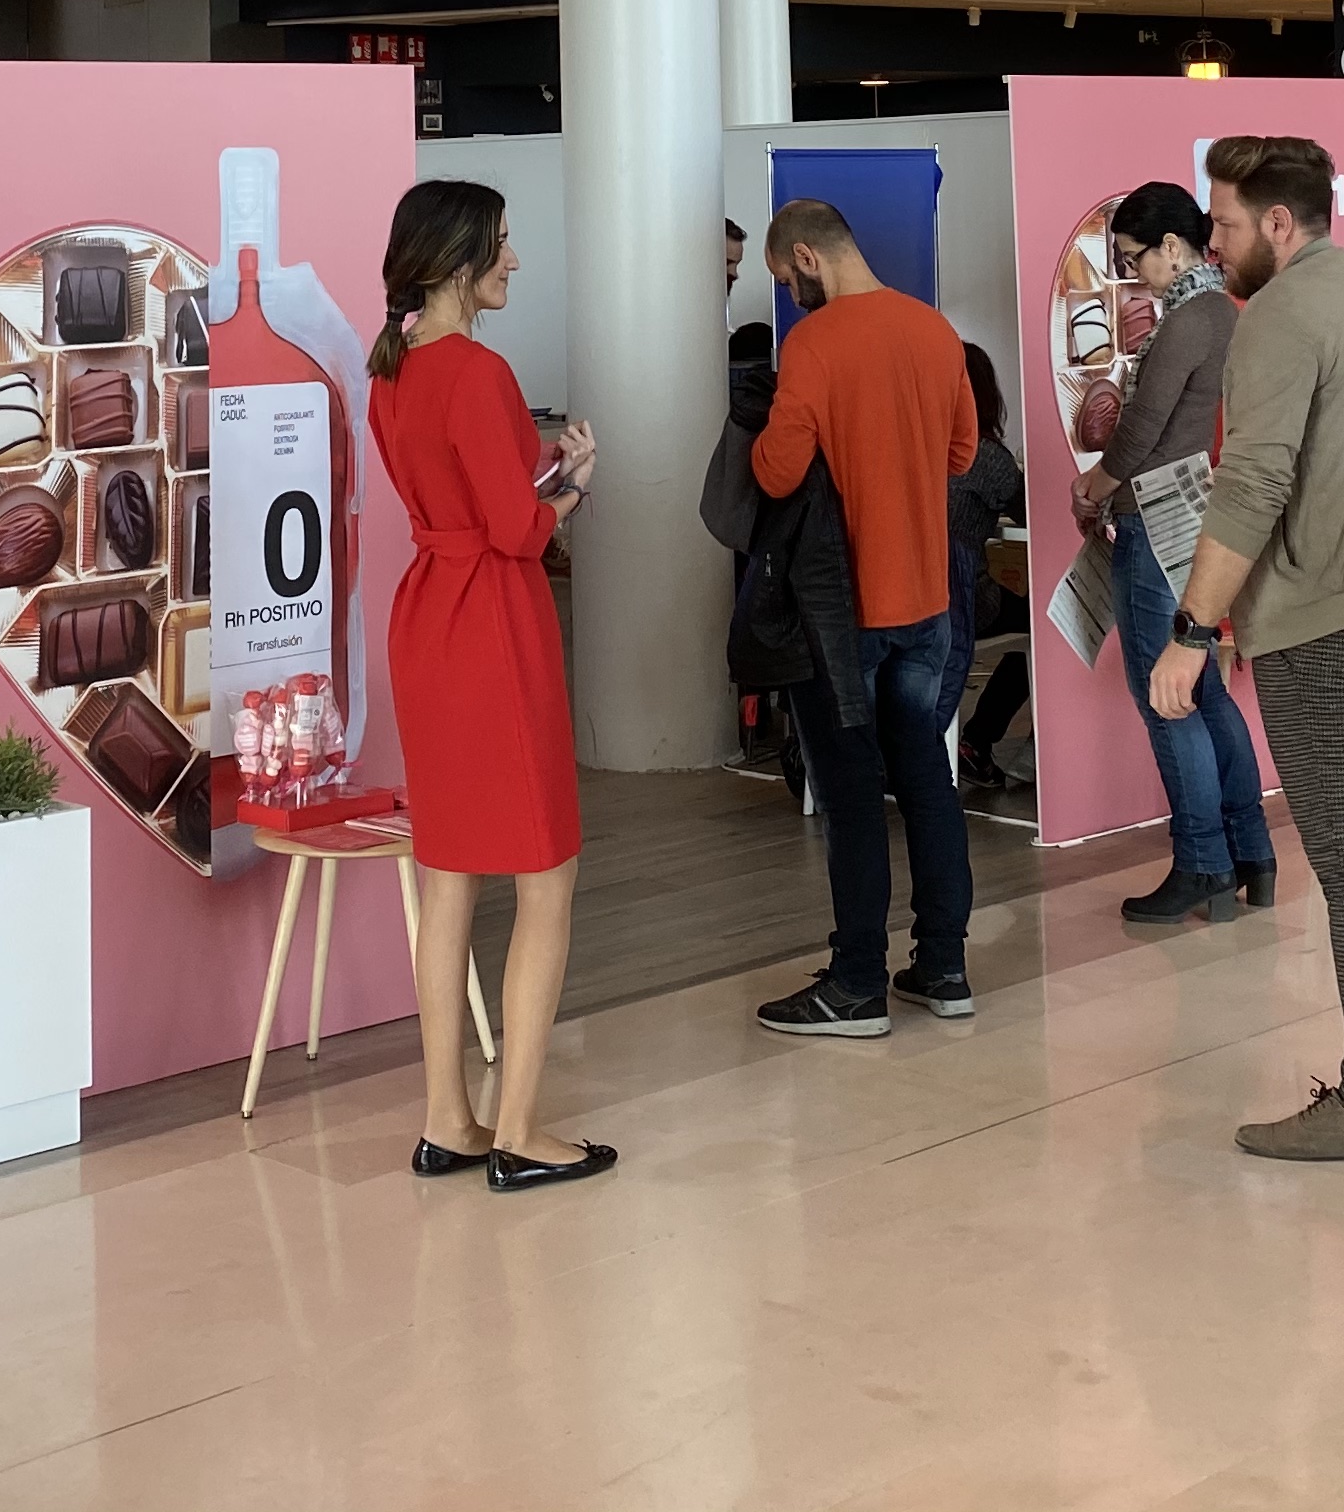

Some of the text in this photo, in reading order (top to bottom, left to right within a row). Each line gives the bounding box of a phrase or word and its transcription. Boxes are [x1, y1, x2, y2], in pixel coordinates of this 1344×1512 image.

[220, 394, 245, 406] FECHA
[220, 408, 248, 421] CADUC.
[225, 599, 323, 629] Rh POSITIVO
[247, 634, 303, 654] Transfusión
